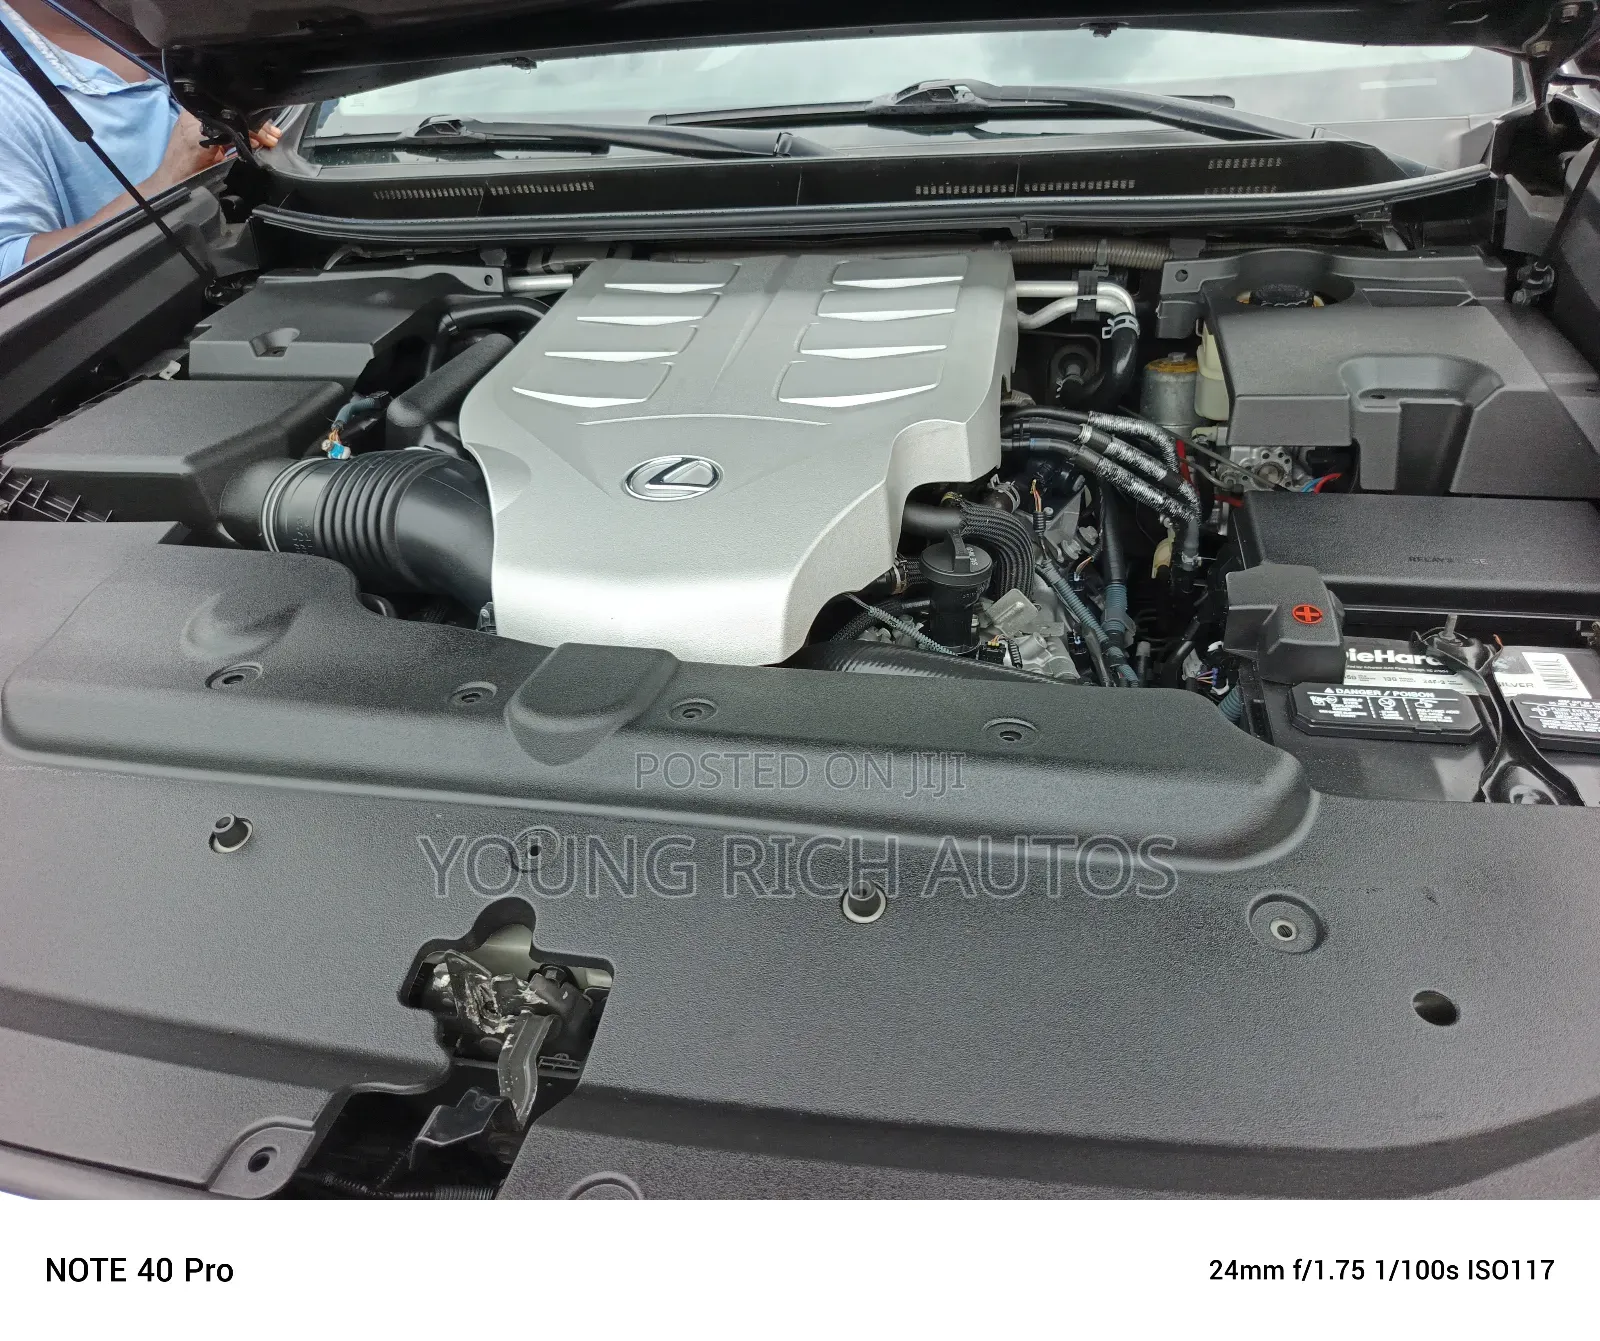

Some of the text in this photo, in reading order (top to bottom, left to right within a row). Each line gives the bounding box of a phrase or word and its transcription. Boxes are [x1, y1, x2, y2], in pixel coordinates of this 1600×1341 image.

[1346, 648, 1444, 666] ieHar
[1335, 688, 1381, 696] DANGER
[1392, 690, 1435, 698] POISON
